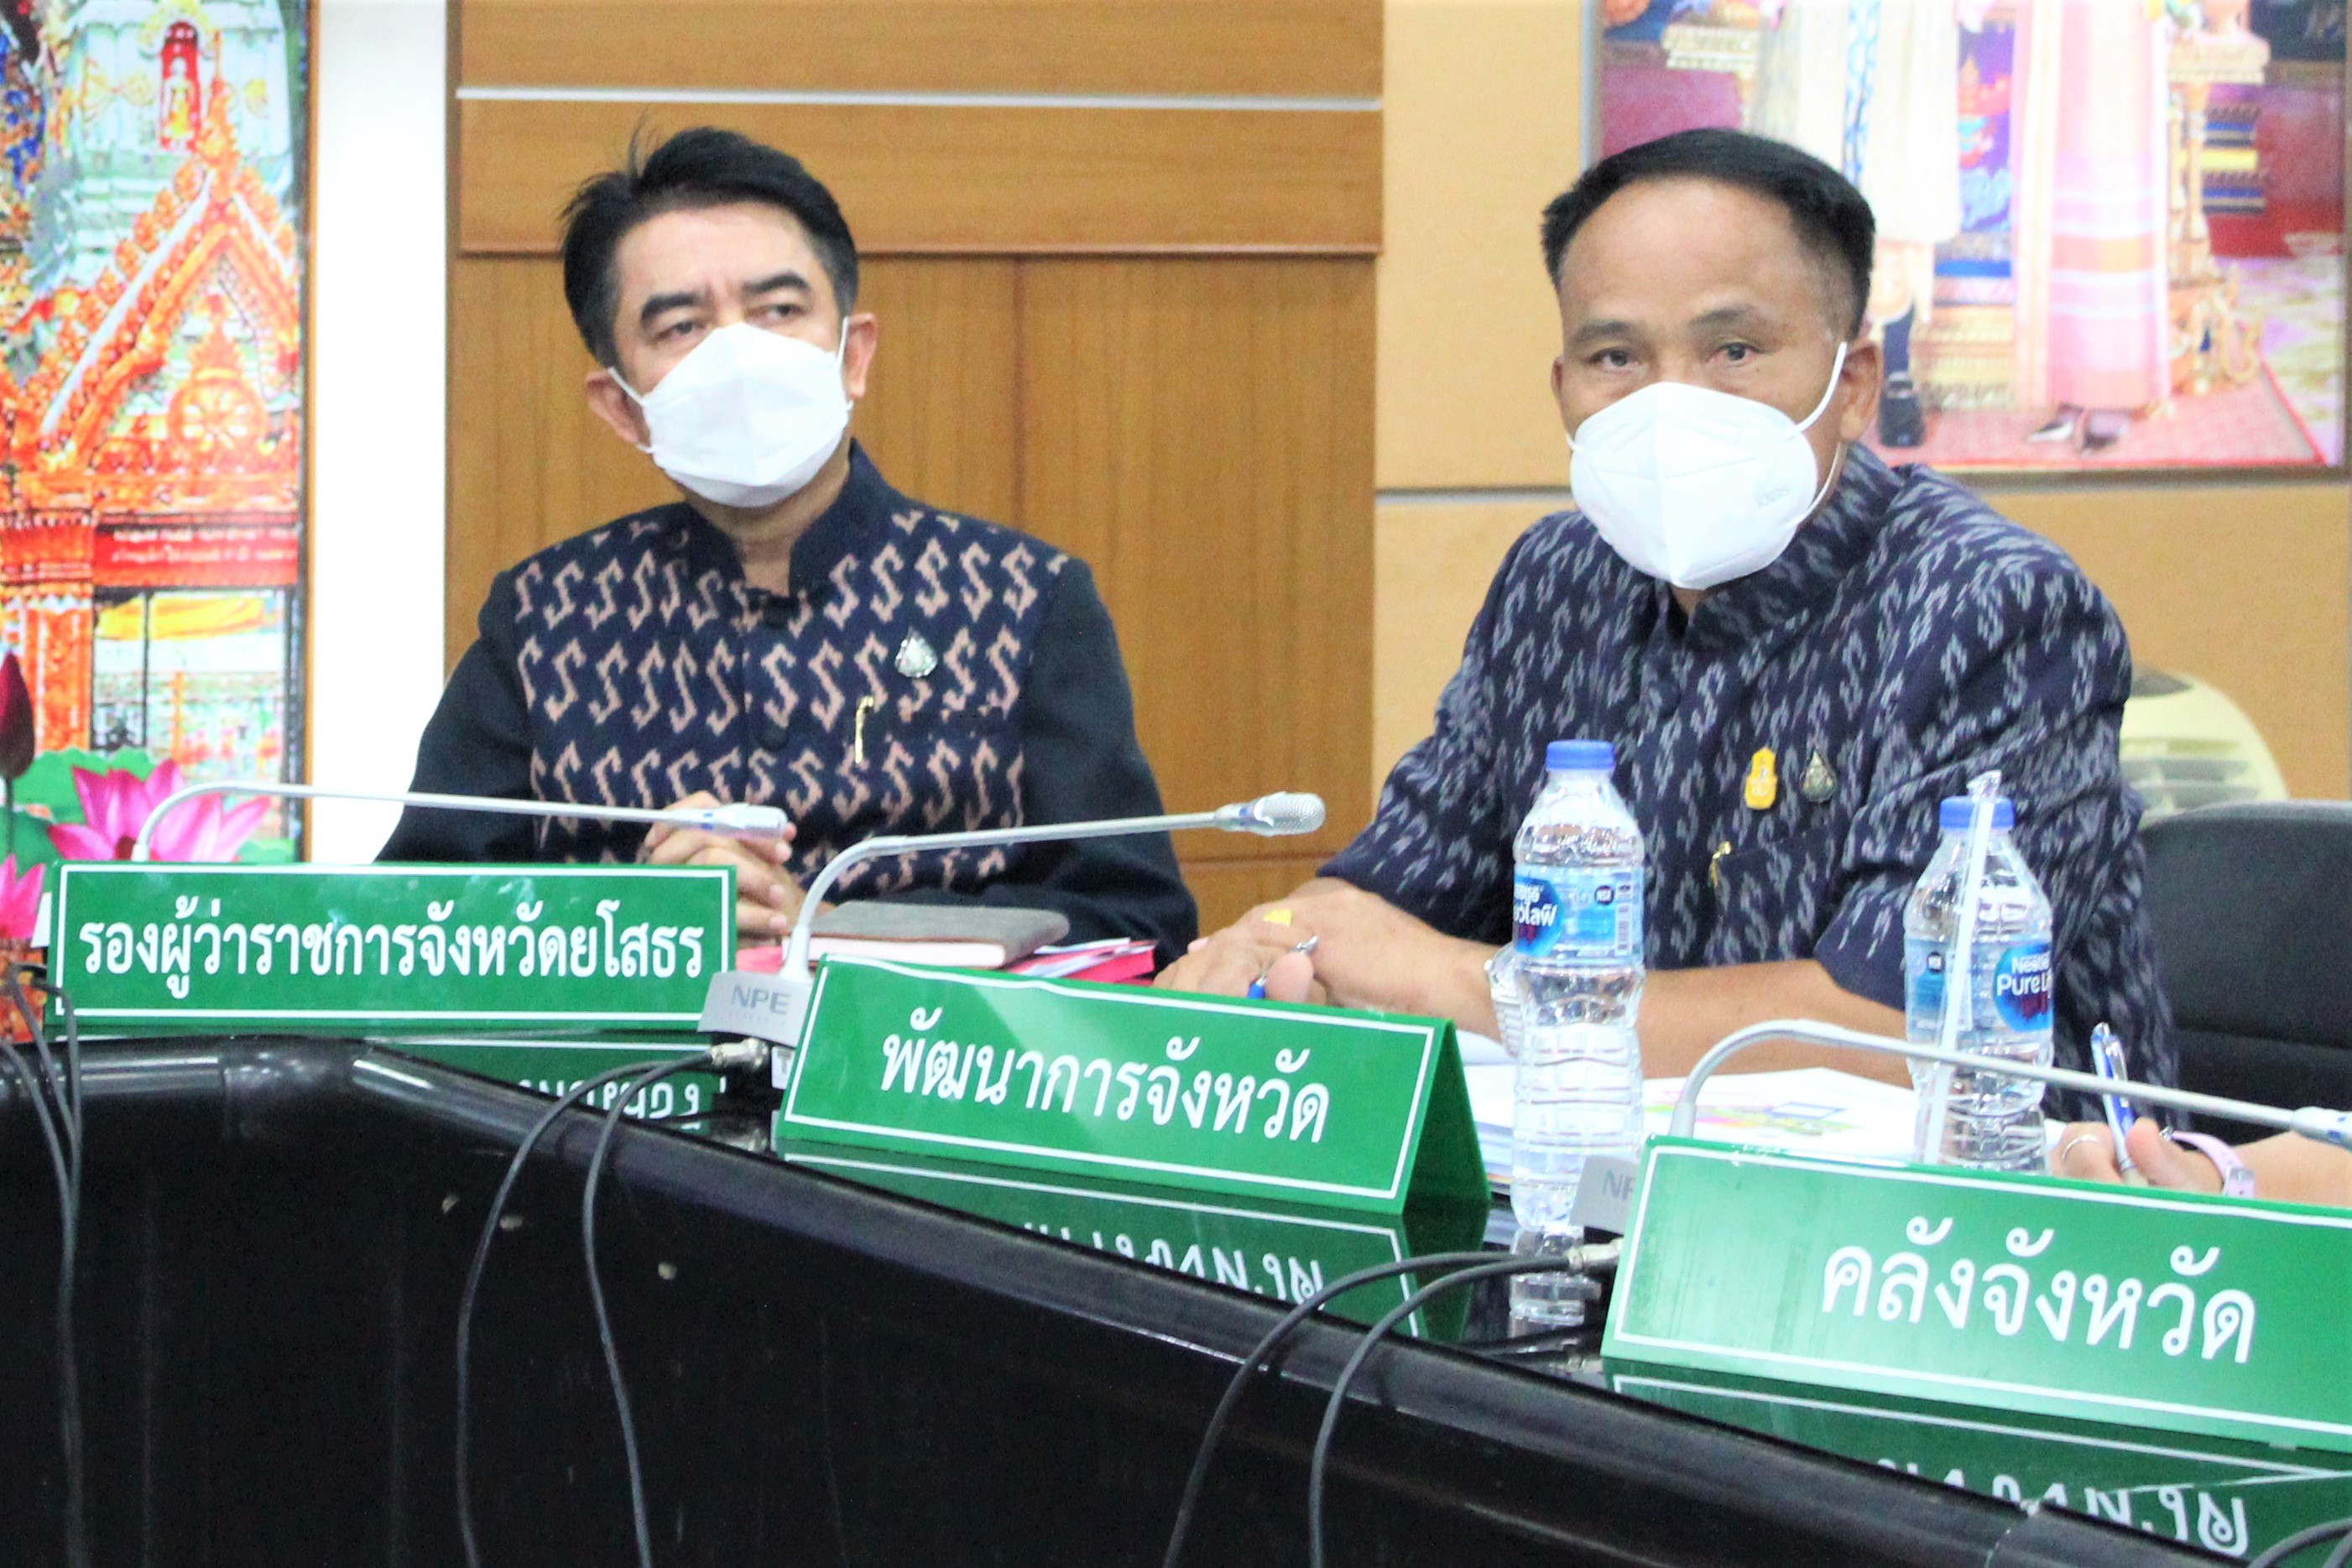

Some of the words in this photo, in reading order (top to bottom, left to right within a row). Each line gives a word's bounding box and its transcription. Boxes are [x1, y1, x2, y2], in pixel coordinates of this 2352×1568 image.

[79, 895, 705, 999] รองผู้ว่าราชการจังหวัดยโสธร
[732, 985, 791, 1014] NPE
[1997, 973, 2040, 997] Pure
[881, 1007, 1331, 1143] พัฒนาการจังหวัด
[1602, 1169, 1635, 1200] NP
[1822, 1216, 2256, 1365] คลังจังหวัด
